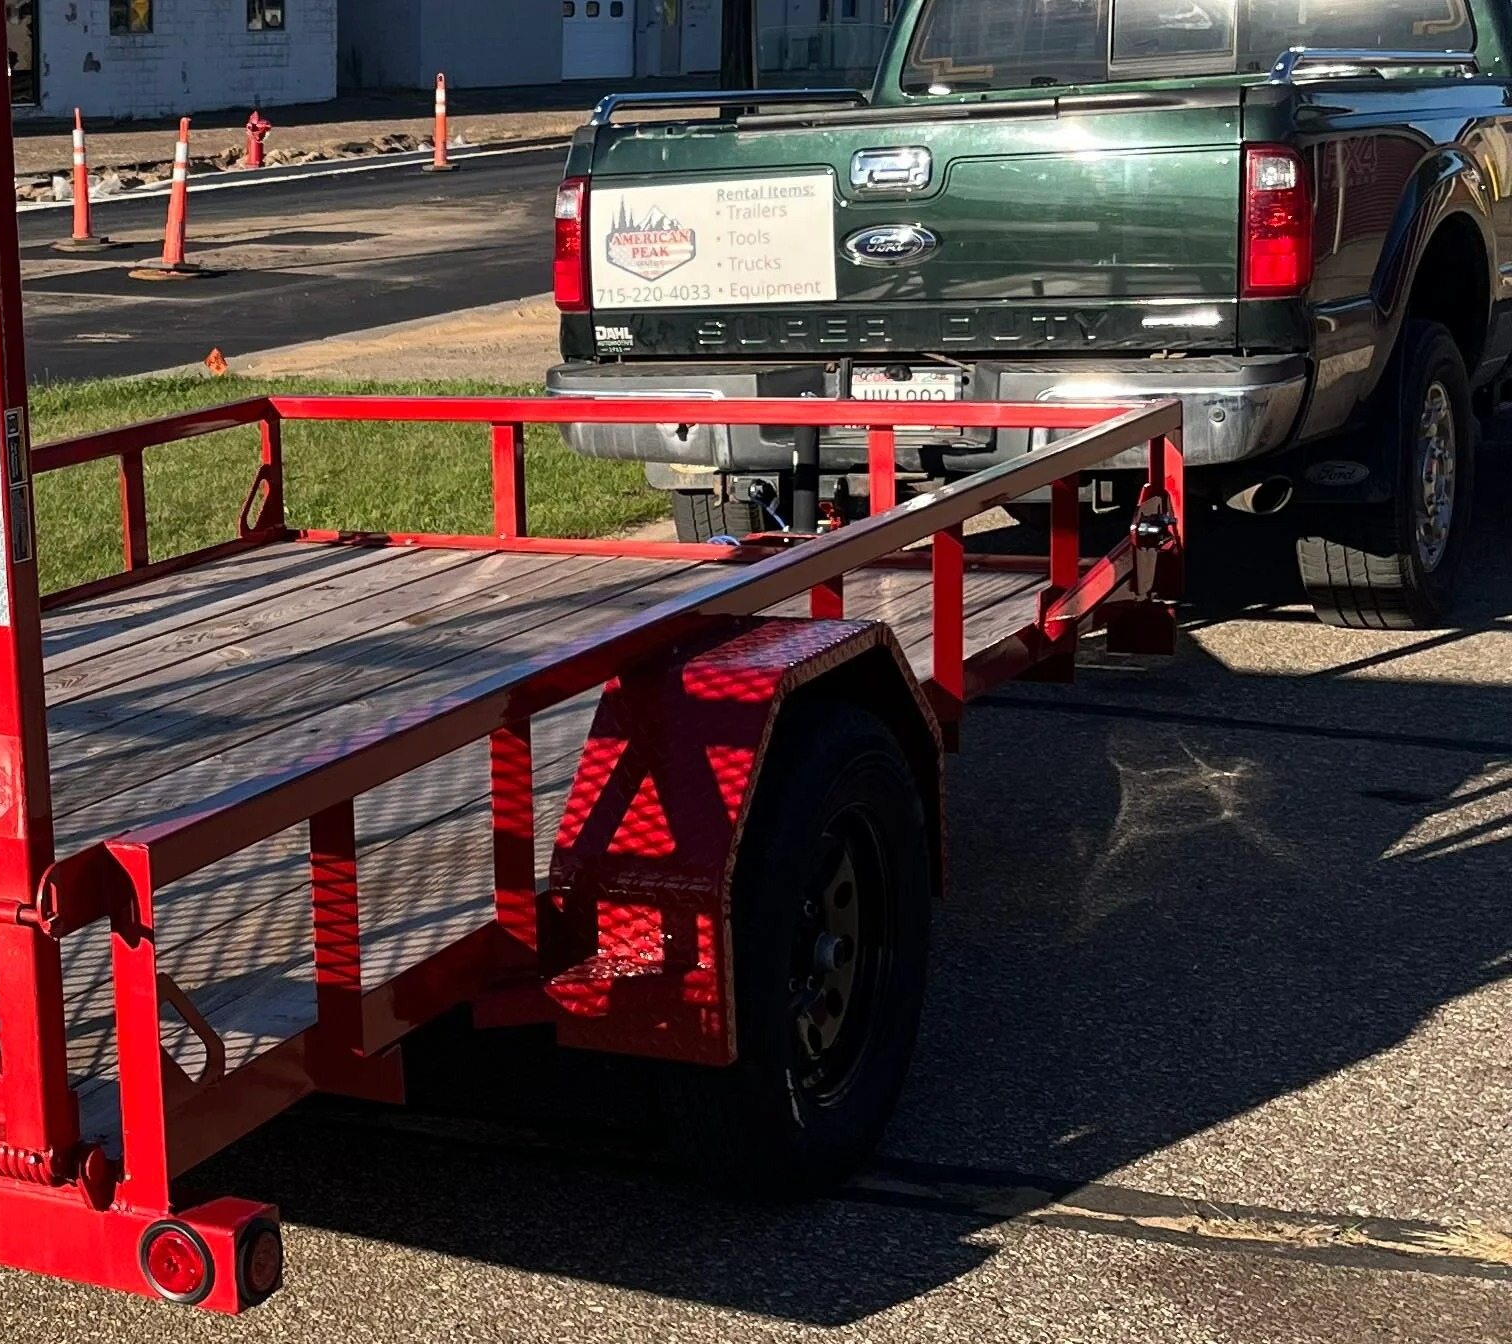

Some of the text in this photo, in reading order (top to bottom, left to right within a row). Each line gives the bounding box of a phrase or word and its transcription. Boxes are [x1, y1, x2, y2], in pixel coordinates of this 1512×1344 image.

[716, 184, 816, 201] Rental Items:
[726, 203, 788, 220] Trailers
[611, 230, 691, 247] AMERICAN
[727, 229, 771, 247] Tools
[631, 247, 670, 259] PEAK
[727, 255, 782, 272] Trucks
[596, 280, 823, 304] 715-220-4033 Equipment
[595, 326, 633, 340] DAHL
[695, 311, 1110, 346] SUPER DUTY
